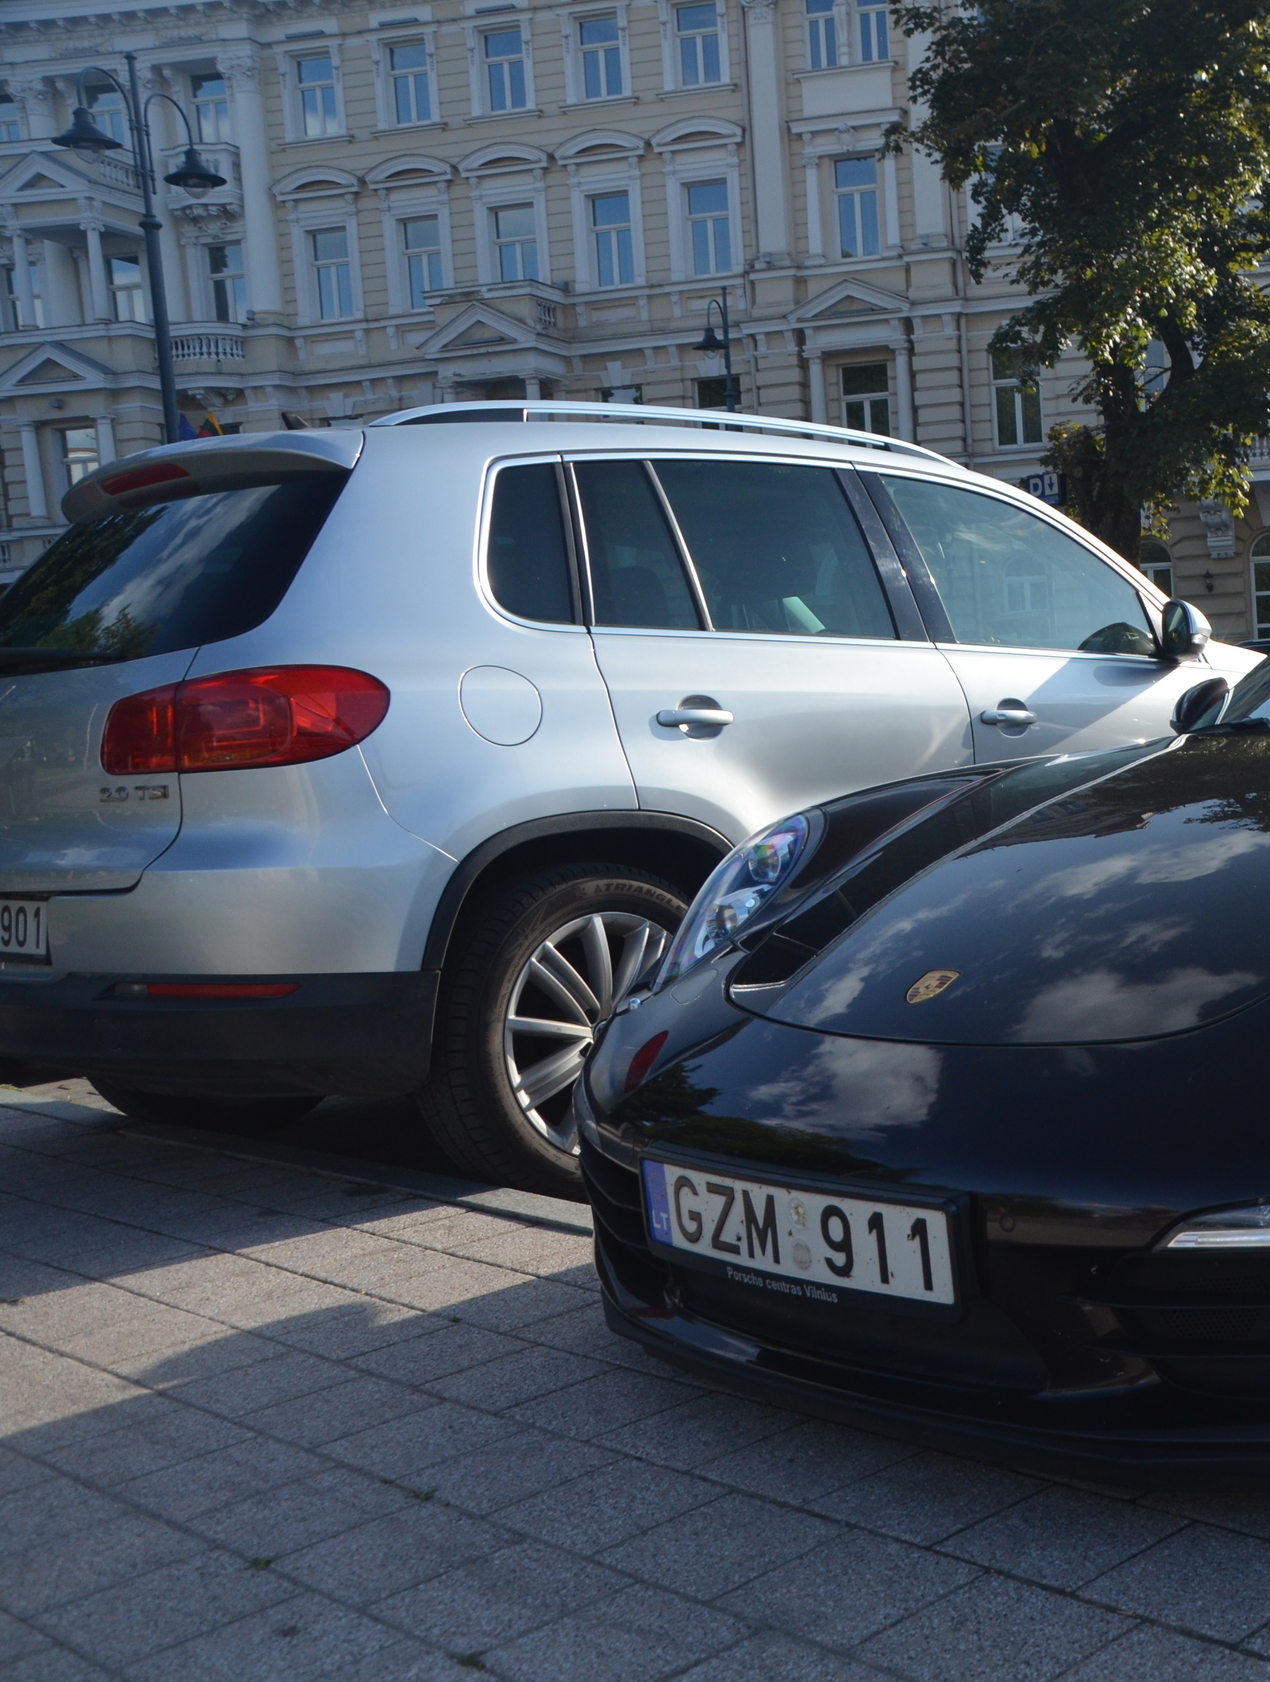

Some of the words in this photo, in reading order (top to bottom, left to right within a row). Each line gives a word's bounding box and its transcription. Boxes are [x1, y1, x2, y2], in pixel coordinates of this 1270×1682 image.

[134, 784, 169, 800] TSI
[603, 883, 687, 914] TRIANGLE
[652, 1209, 668, 1230] LT
[673, 1175, 781, 1265] GZM
[820, 1204, 934, 1291] 911
[726, 1266, 764, 1287] Porsche
[765, 1279, 803, 1296] centras
[803, 1284, 838, 1303] Vilnius
